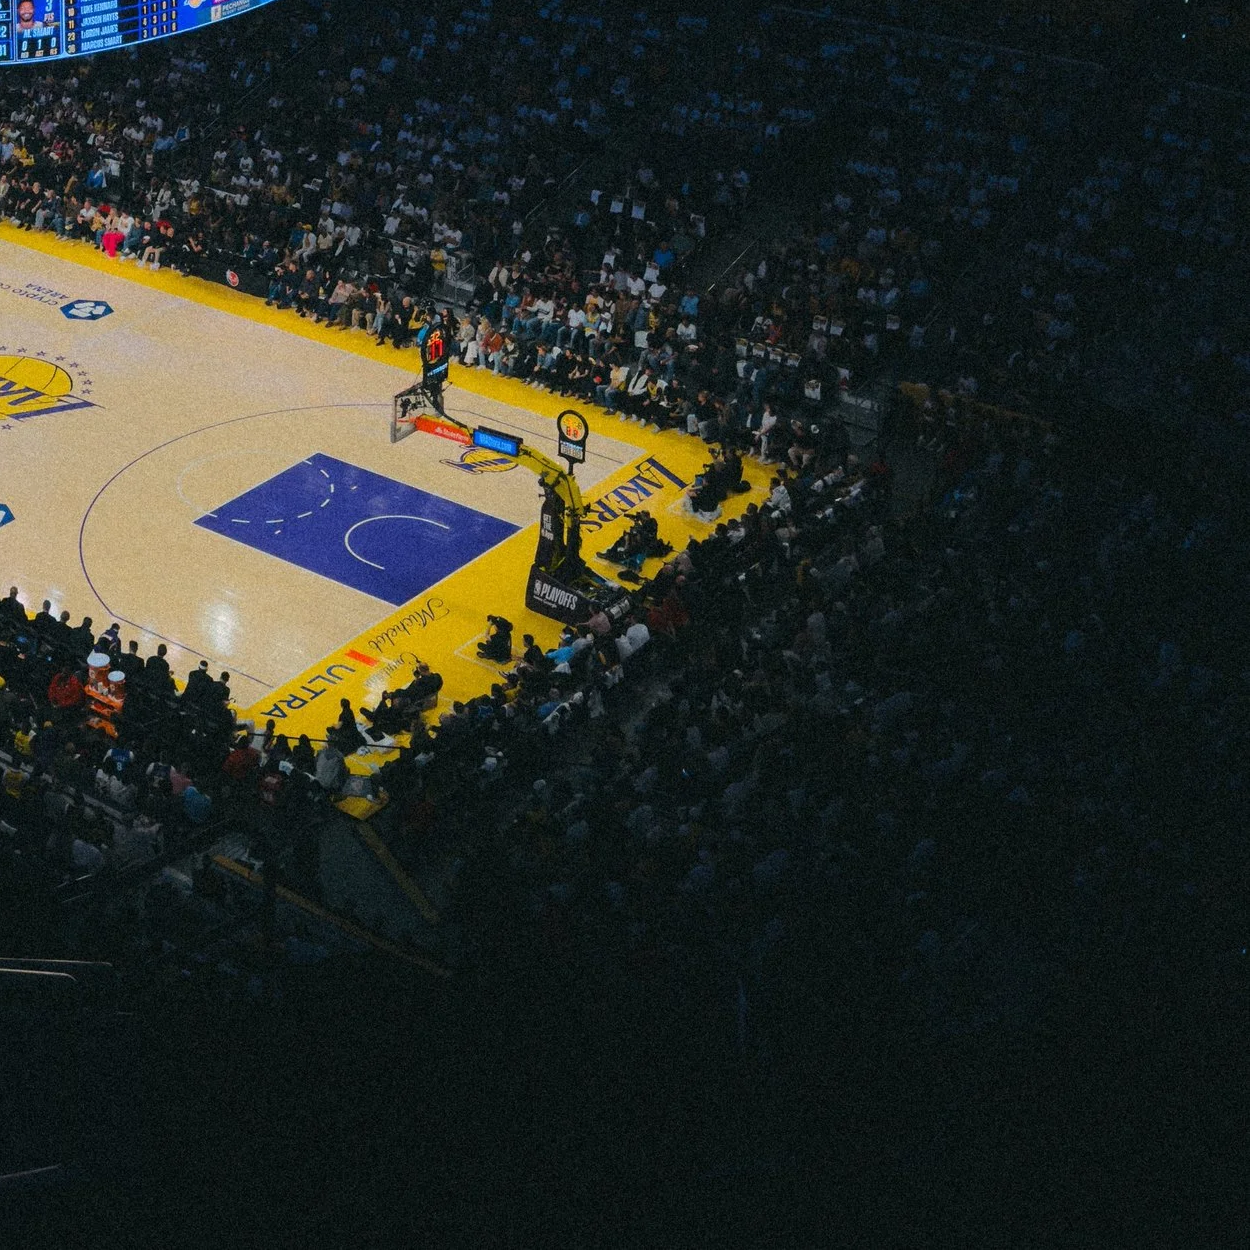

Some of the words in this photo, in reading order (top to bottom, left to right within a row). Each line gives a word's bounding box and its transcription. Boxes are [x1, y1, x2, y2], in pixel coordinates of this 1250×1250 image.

[25, 283, 69, 299] ARENA
[579, 453, 694, 533] LAKERS
[541, 583, 578, 610] PLAYOFFS
[367, 597, 450, 654] Michelob
[260, 664, 357, 720] ULTRA
